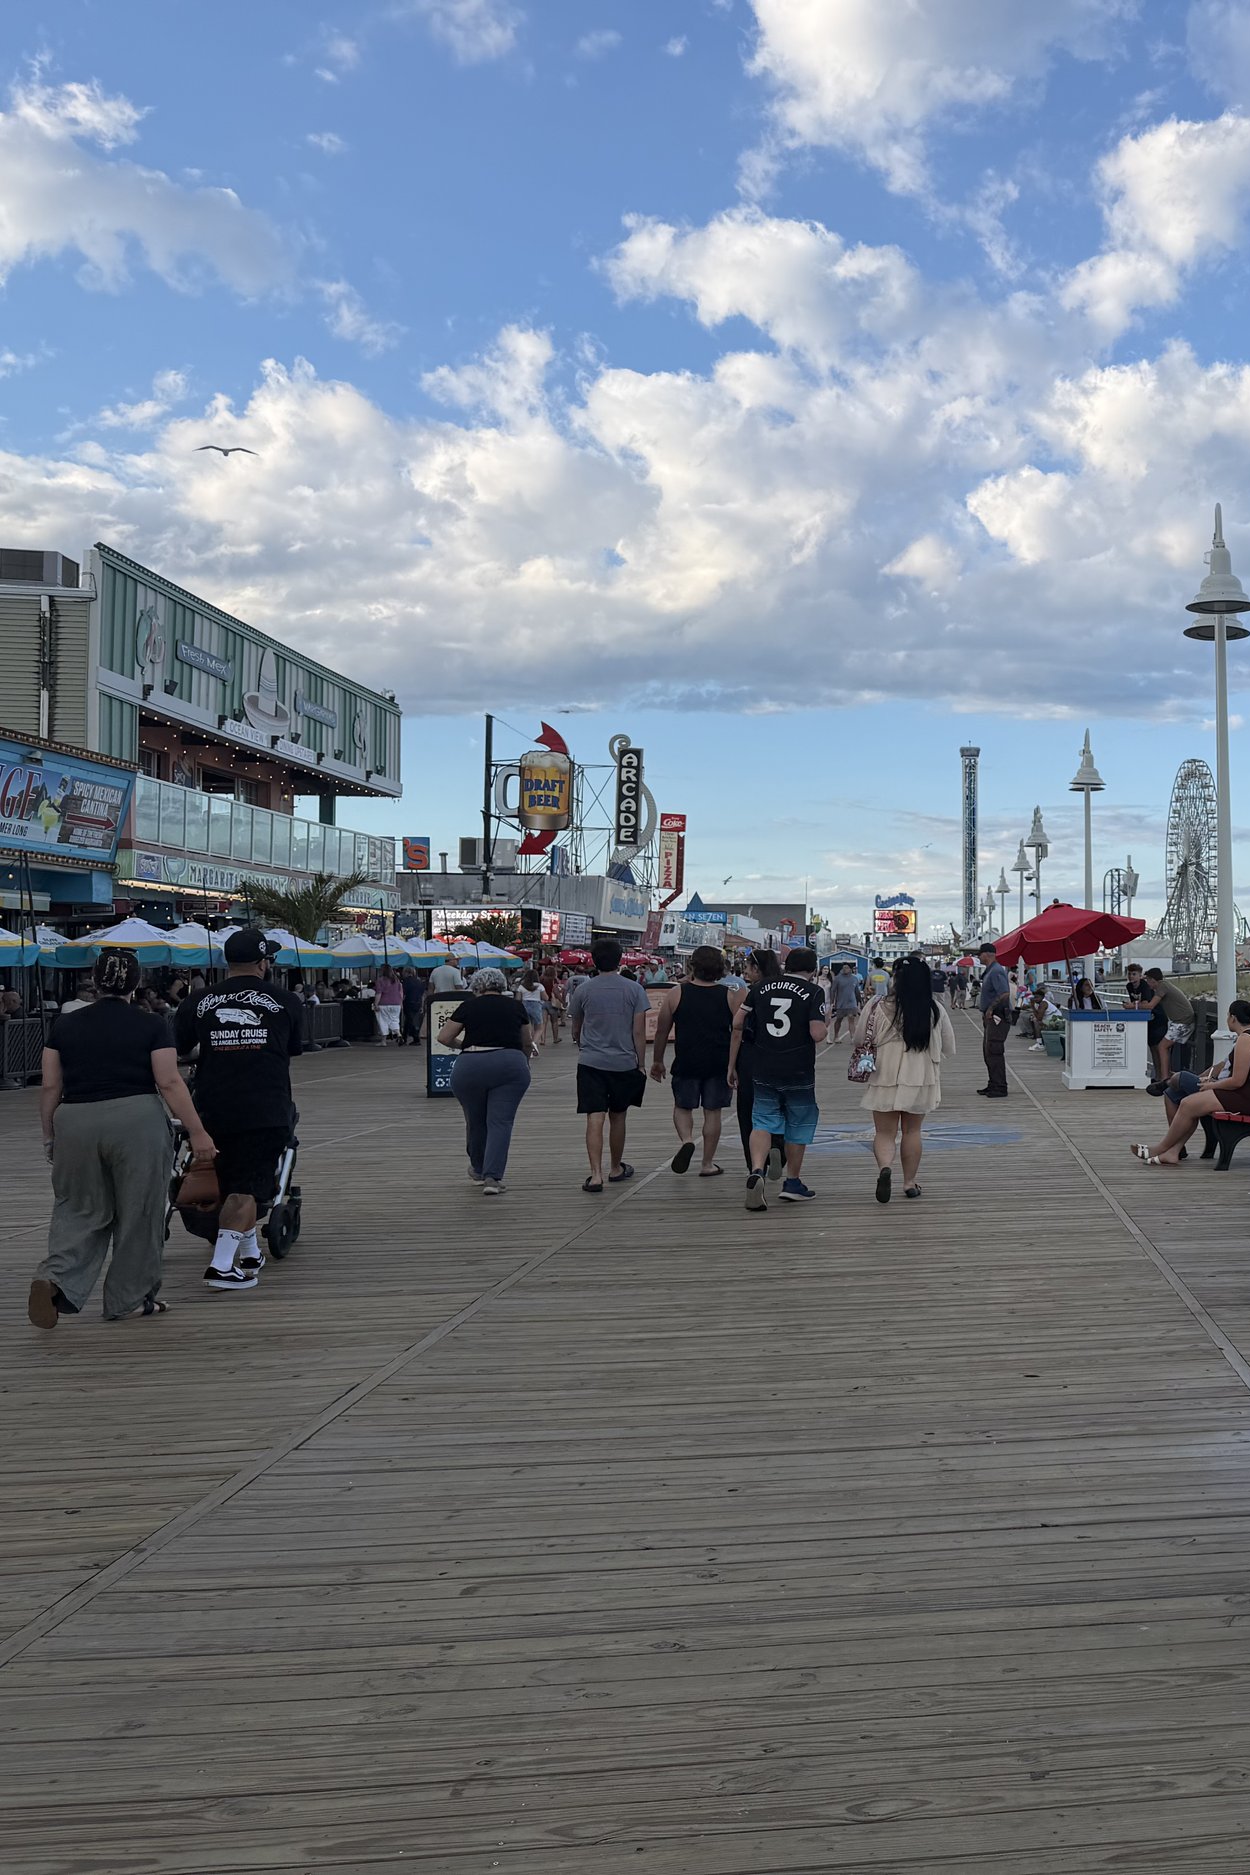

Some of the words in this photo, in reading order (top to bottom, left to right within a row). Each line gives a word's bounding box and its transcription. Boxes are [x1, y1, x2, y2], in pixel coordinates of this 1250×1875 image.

[181, 645, 205, 664] Fresh
[206, 657, 226, 674] Mex
[229, 722, 250, 740] OCEAN
[73, 780, 93, 799] SPICY
[94, 786, 123, 805] MEXICAN
[523, 779, 566, 794] DRAFT
[527, 794, 561, 809] BEER
[619, 752, 639, 842] ARCADE
[80, 799, 109, 818] CANTINA
[662, 851, 673, 888] PIZZA
[437, 910, 478, 921] Weekday
[760, 981, 811, 1001] CUCURELLA
[197, 993, 227, 1018] Born
[766, 997, 793, 1038] 3
[210, 1029, 240, 1040] SUNDAY
[240, 1028, 268, 1038] CRUISE
